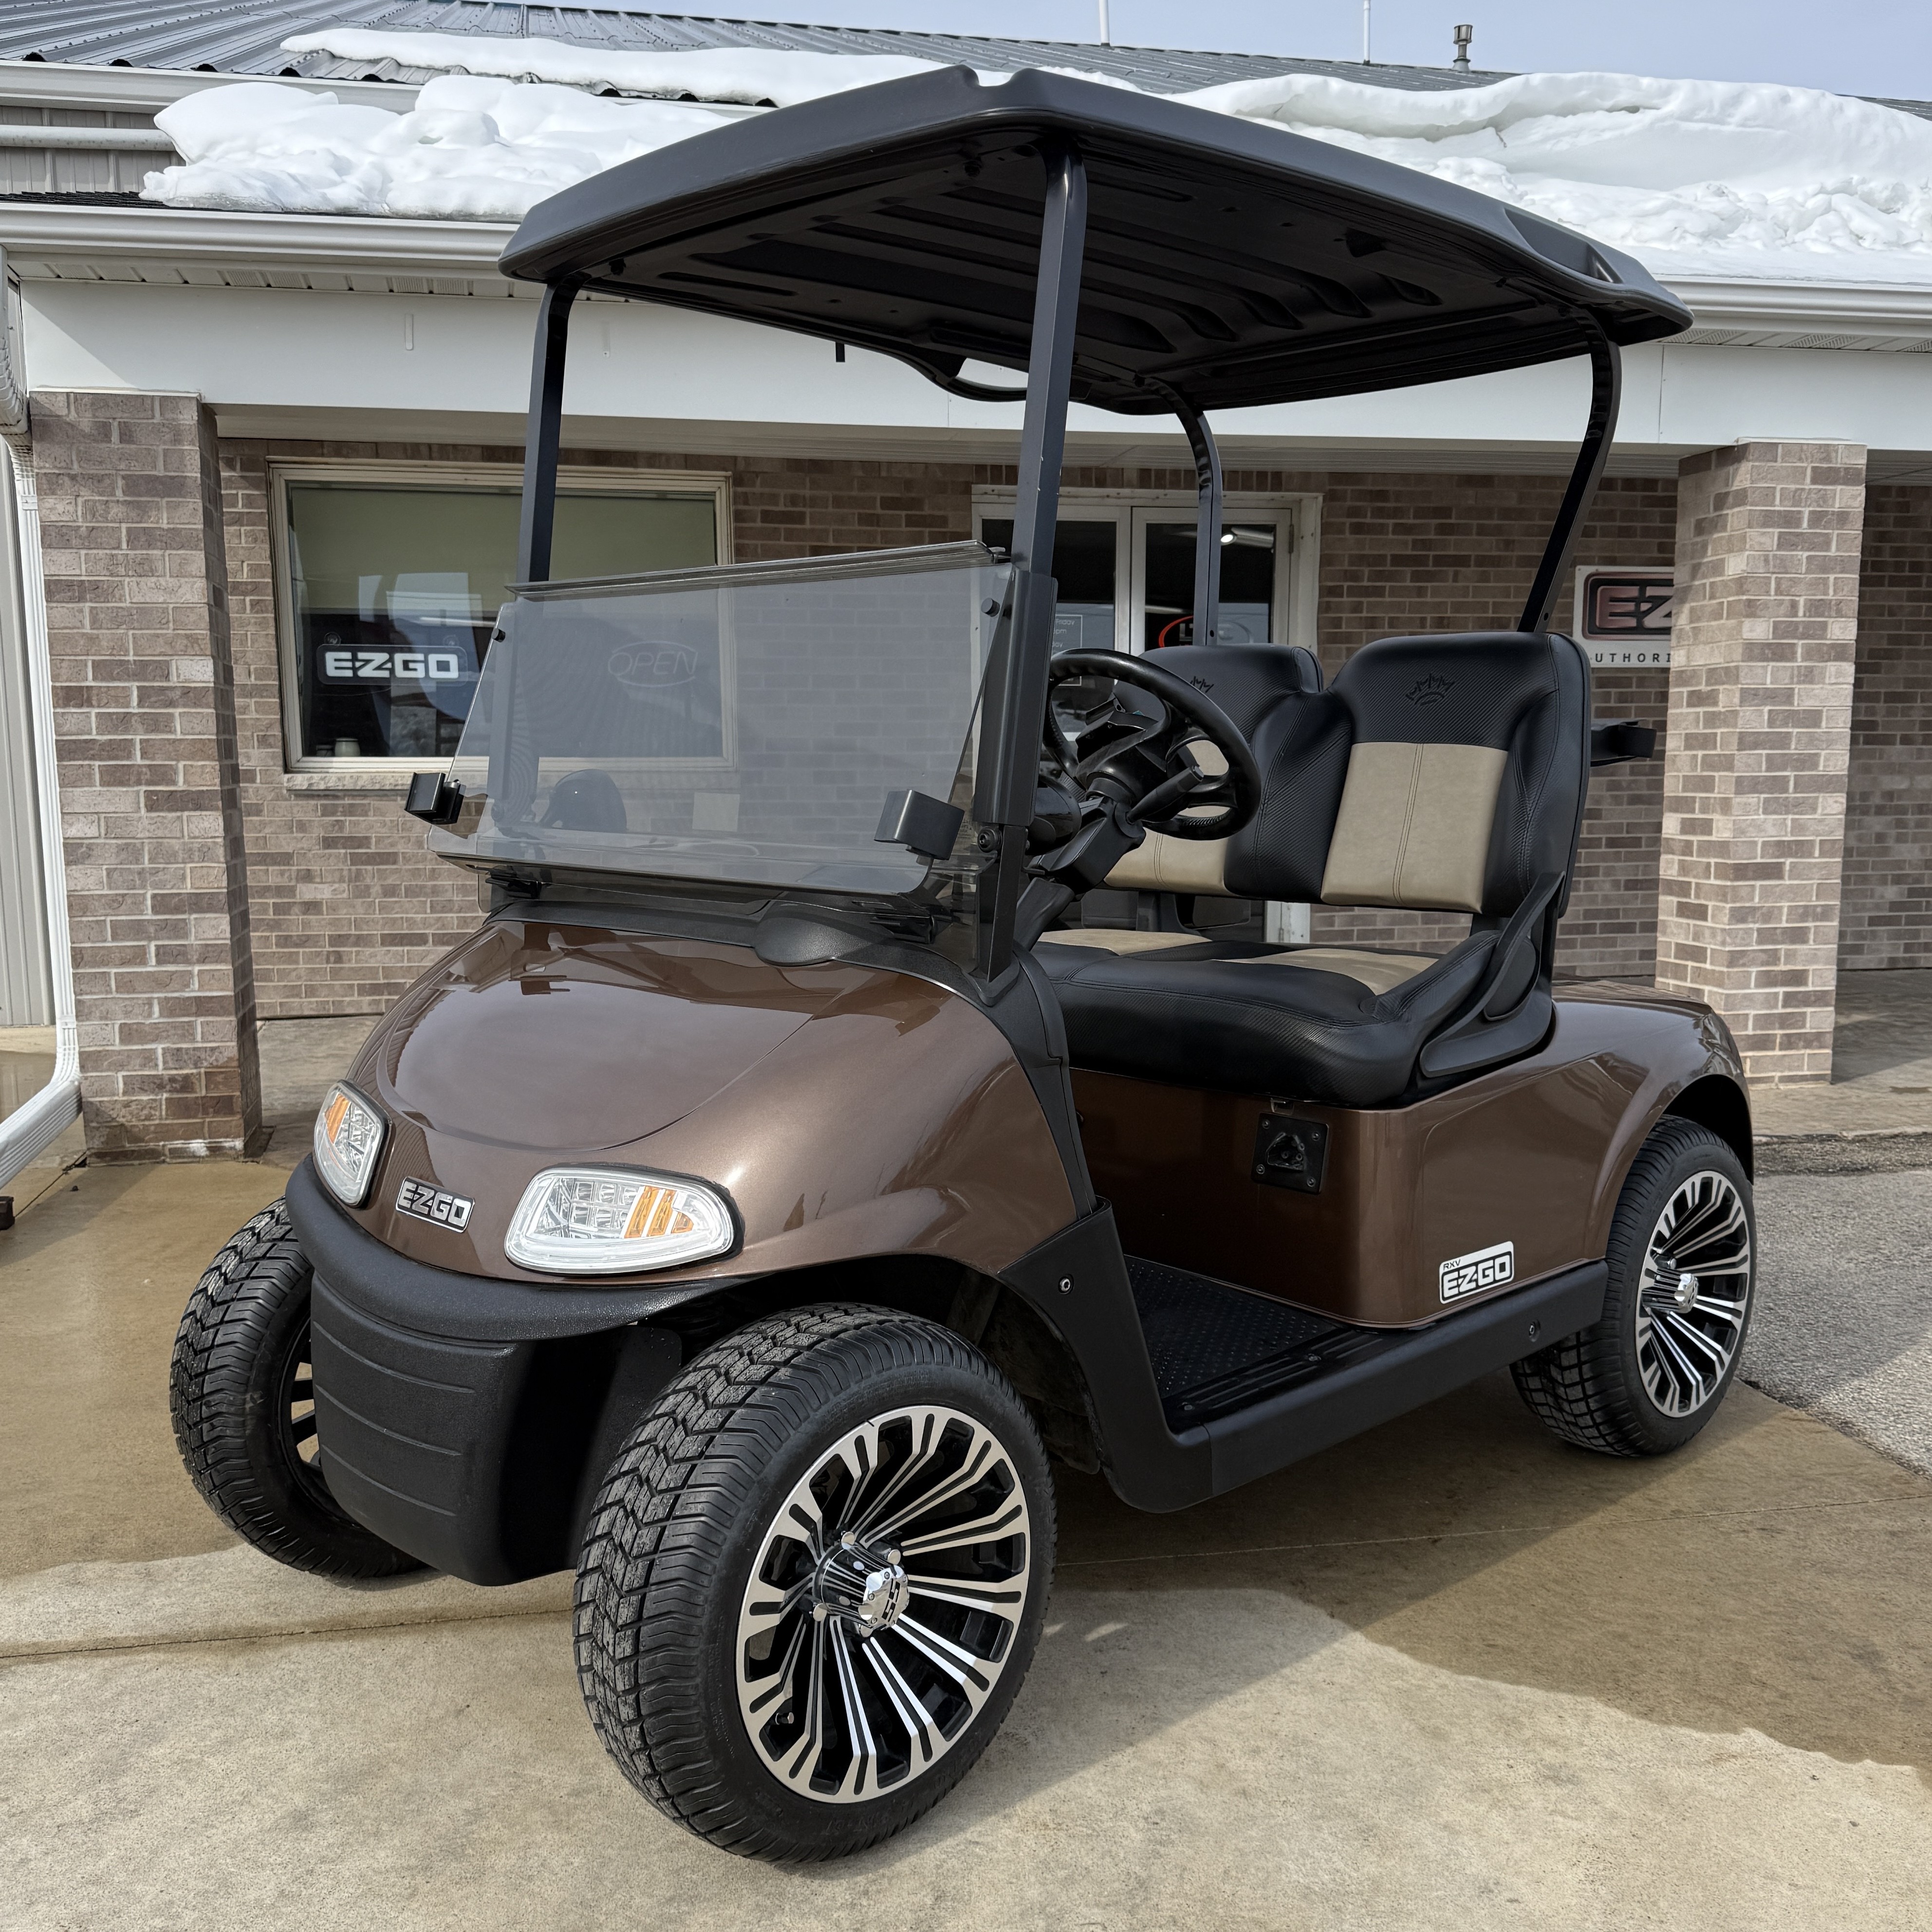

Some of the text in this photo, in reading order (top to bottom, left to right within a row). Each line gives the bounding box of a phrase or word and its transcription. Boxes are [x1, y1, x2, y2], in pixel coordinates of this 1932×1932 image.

[1596, 586, 1673, 629] EZ
[608, 651, 698, 676] OPEN
[1595, 652, 1671, 663] UTHORI
[1443, 1259, 1461, 1271] RXV
